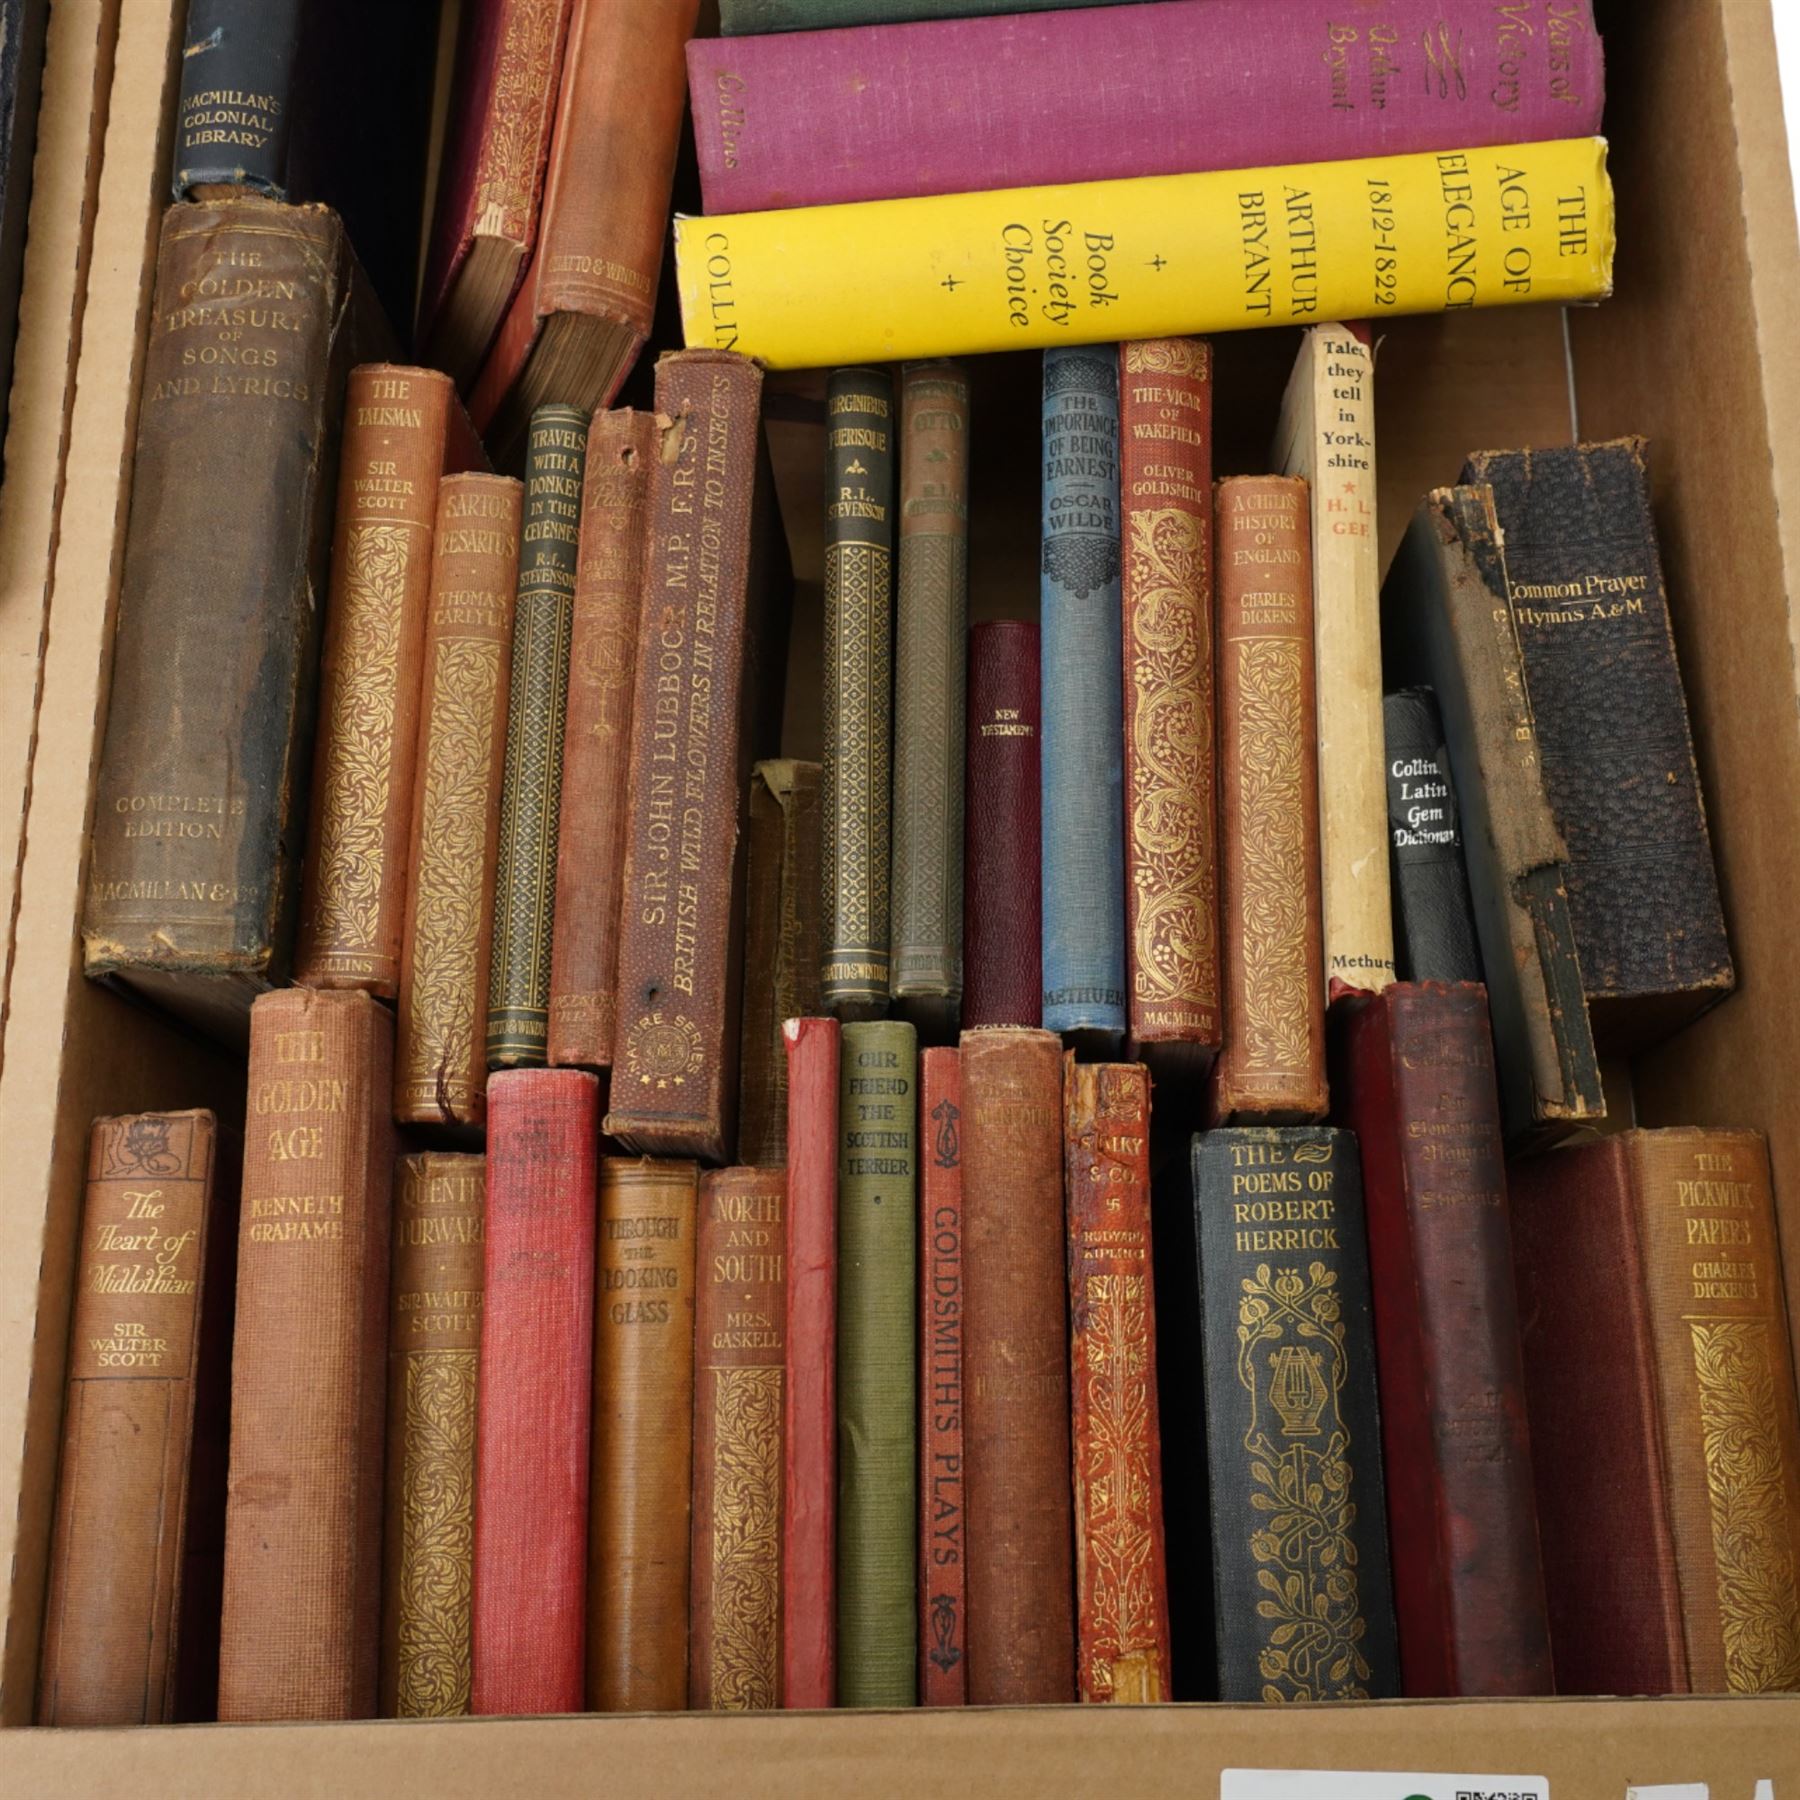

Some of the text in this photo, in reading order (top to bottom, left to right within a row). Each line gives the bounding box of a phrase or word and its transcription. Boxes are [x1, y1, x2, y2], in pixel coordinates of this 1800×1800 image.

[183, 89, 281, 116] MACMILLAN'S
[184, 110, 273, 132] COLONIAL
[717, 69, 746, 169] Collins
[185, 129, 268, 148] LIBRARY
[1496, 163, 1532, 294] AGE OF
[1557, 186, 1588, 257] THE
[1283, 185, 1317, 316] ARTHUR
[1367, 178, 1397, 305] 1812-1822
[212, 250, 262, 268] THE
[1238, 190, 1272, 317] BRYANT
[1001, 222, 1031, 328] Choice
[1042, 219, 1076, 327] Society
[1084, 231, 1119, 309] Book
[181, 278, 295, 300] GOLDEN
[218, 331, 243, 342] OF
[182, 347, 278, 367] SONGS
[1328, 362, 1364, 383] they
[152, 375, 309, 401] AND LYRICS
[372, 379, 411, 400] THE
[1333, 386, 1362, 401] tell
[1061, 395, 1098, 410] THE
[358, 407, 423, 429] TALISMAN
[1045, 413, 1117, 437] IMPORTANCE
[1159, 408, 1180, 422] OF
[1338, 408, 1355, 422] in
[532, 428, 586, 452] TRAVELS
[1132, 425, 1201, 446] WAKEFIELD
[1322, 431, 1372, 447] York-
[1050, 436, 1113, 459] OF BEING
[367, 461, 397, 476] SIR
[534, 453, 566, 471] WITH
[568, 457, 580, 474] A
[671, 427, 699, 516] F.R.S.
[1046, 457, 1116, 481] EARNEST
[1327, 454, 1369, 470] shire
[1144, 465, 1194, 483] OLIVER
[354, 478, 415, 495] WALTER
[529, 475, 581, 499] DONKEY
[357, 496, 407, 510] SCOTT
[446, 493, 512, 521] SARTOR
[531, 499, 576, 519] IN THE
[1050, 494, 1112, 511] OSCAR
[1233, 495, 1245, 512] A
[1326, 498, 1348, 513] H.
[1048, 512, 1113, 531] WILDE
[1233, 515, 1297, 531] HISTORY
[439, 529, 515, 557] RESARTUS
[1254, 532, 1275, 545] OF
[666, 532, 692, 590] M.P.
[1233, 550, 1301, 566] ENGLAND
[1585, 574, 1648, 597] Prayer
[438, 590, 507, 609] THOMAS
[1240, 592, 1296, 608] CHARLES
[1241, 609, 1297, 625] DICKENS
[1518, 607, 1585, 628] Hymns
[673, 374, 732, 996] BRITISH WILD FLOWERS IN RELATION TO INSECTS
[995, 709, 1020, 721] NEW
[981, 724, 1034, 737] TESTAMENT
[1400, 782, 1448, 801] Latin
[116, 796, 245, 815] COMPLETE
[648, 773, 674, 861] JOHN
[1407, 805, 1443, 828] Gem
[125, 822, 222, 839] EDITION
[210, 882, 230, 902] &
[642, 868, 668, 926] SIR
[1143, 1011, 1213, 1030] MACMILLAN
[275, 1031, 325, 1064] THE
[626, 1011, 704, 1075] NATURE SERIES
[858, 1052, 900, 1068] OUR
[848, 1078, 909, 1095] FRIEND
[255, 1080, 348, 1115] GOLDEN
[859, 1104, 895, 1121] THE
[269, 1126, 323, 1161] AGE
[846, 1132, 909, 1148] SCOTTISH
[1080, 1135, 1144, 1156] SALKY
[1231, 1143, 1286, 1166] THE
[1694, 1153, 1733, 1172] THE
[847, 1159, 910, 1175] TERRIER
[1089, 1166, 1140, 1185] & CO.
[1232, 1171, 1334, 1195] POEMS OF
[122, 1189, 165, 1219] The
[251, 1195, 344, 1217] KENNETH
[716, 1196, 782, 1223] NORTH
[250, 1220, 344, 1243] GRAHAME
[604, 1217, 680, 1240] THROUGH
[1686, 1218, 1752, 1245] PAPERS
[93, 1223, 196, 1265] Heart of
[726, 1231, 770, 1248] AND
[1236, 1228, 1340, 1251] HERRICK
[624, 1247, 657, 1260] THE
[88, 1263, 196, 1295] Midlothian
[604, 1266, 679, 1290] LOOKING
[714, 1255, 783, 1283] SOUTH
[1692, 1262, 1757, 1279] CHARLES
[611, 1300, 670, 1324] GLASS
[727, 1312, 772, 1328] MRS.
[114, 1323, 146, 1338] SIR
[412, 1314, 477, 1332] SCOTT
[90, 1338, 167, 1352] WALTER
[712, 1333, 783, 1349] GASKELL
[98, 1353, 162, 1367] SCOTT
[933, 1452, 960, 1566] PLAYS
